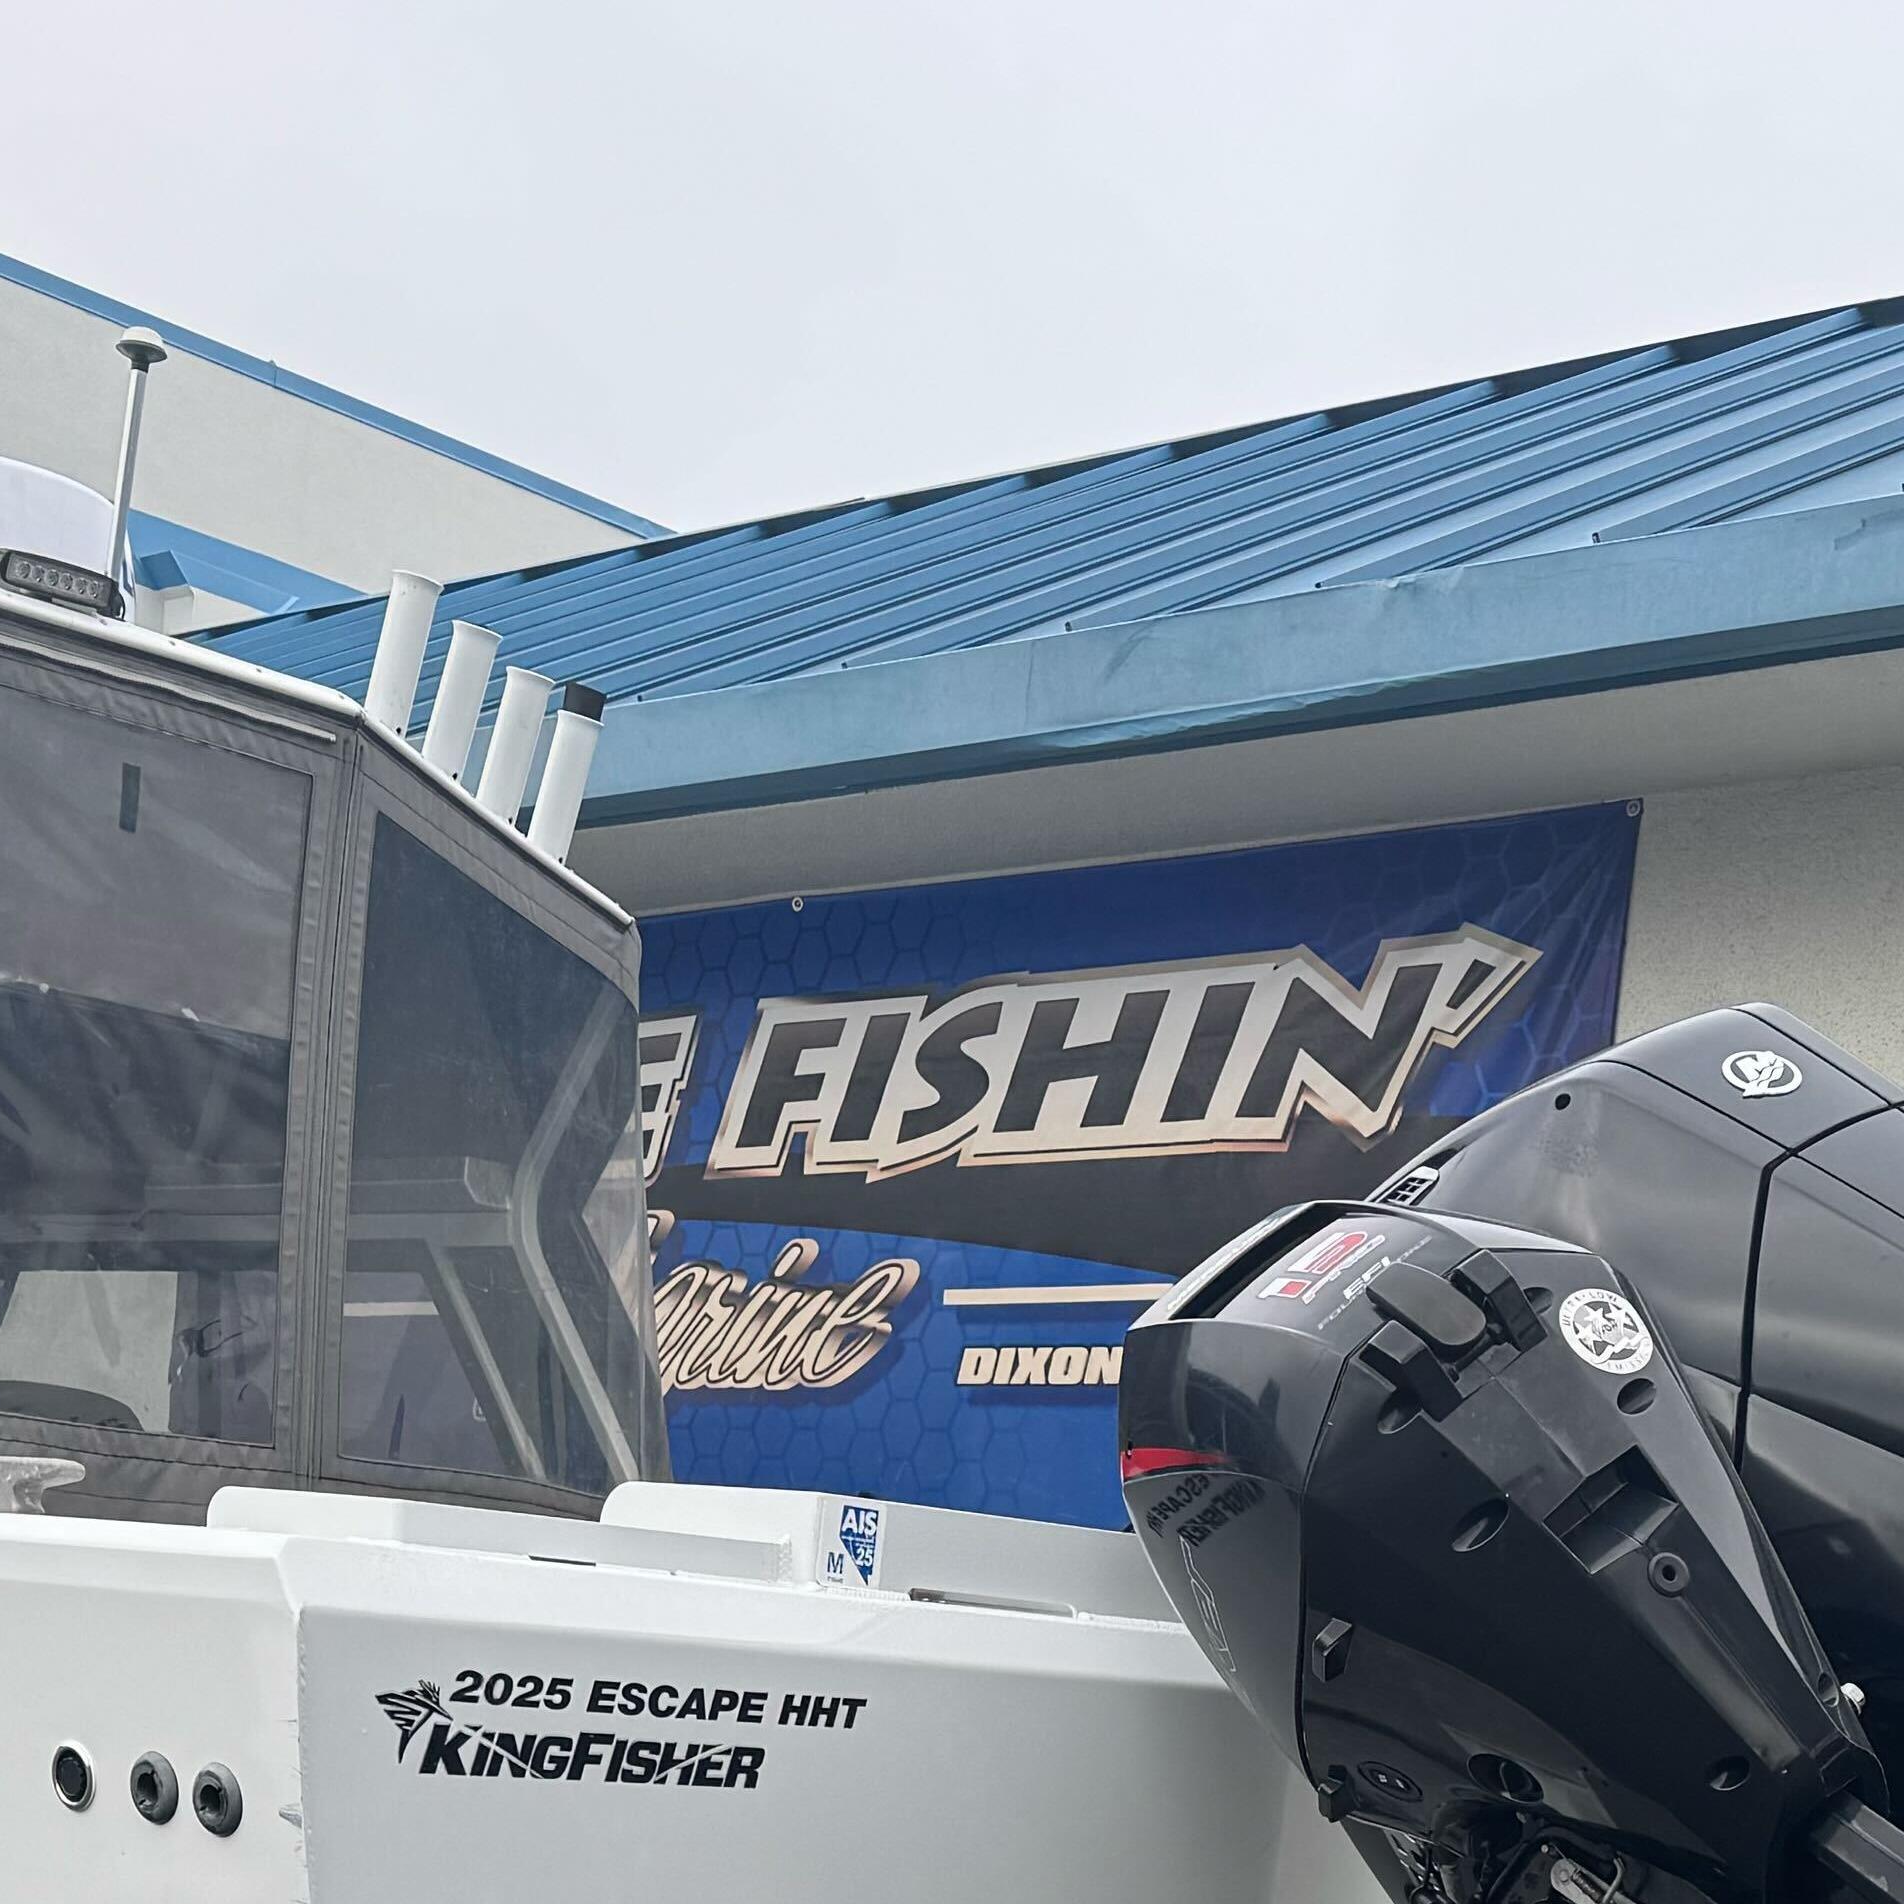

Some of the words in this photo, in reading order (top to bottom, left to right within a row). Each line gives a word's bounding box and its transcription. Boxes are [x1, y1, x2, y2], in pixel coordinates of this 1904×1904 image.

[956, 1346, 1124, 1386] DIXON
[841, 1508, 878, 1536] AIS
[826, 1551, 845, 1574] M
[856, 1547, 874, 1567] 25
[449, 1669, 574, 1711] 2025
[586, 1680, 769, 1724] ESCAPE
[777, 1694, 868, 1730] HHT
